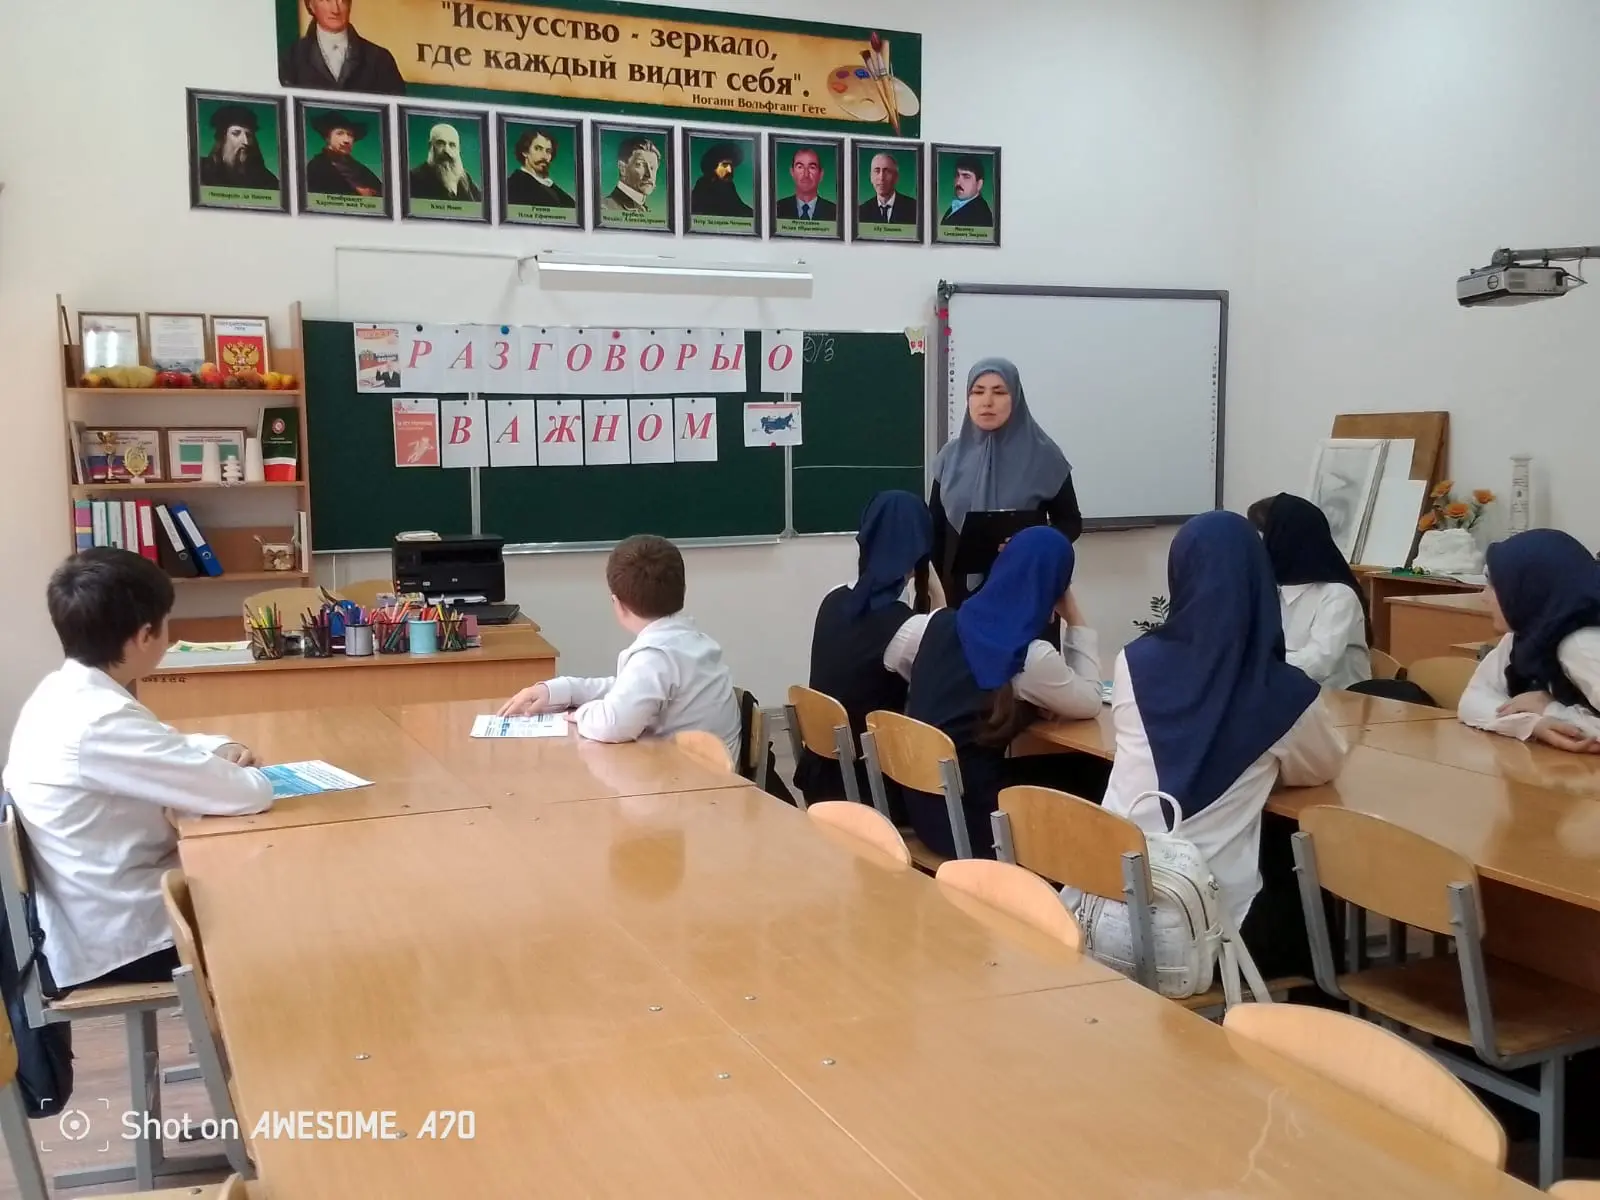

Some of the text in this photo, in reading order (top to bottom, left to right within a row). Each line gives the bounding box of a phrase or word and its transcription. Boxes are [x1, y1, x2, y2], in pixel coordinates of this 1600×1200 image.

[441, 0, 620, 44] "Искусство
[650, 28, 778, 61] зеркало,
[415, 42, 810, 99] где каждый видит себя".
[737, 97, 799, 113] Вольфганг
[407, 339, 794, 372] РАЗГОВОРЫ О
[449, 413, 713, 445] ВАЖНОМ
